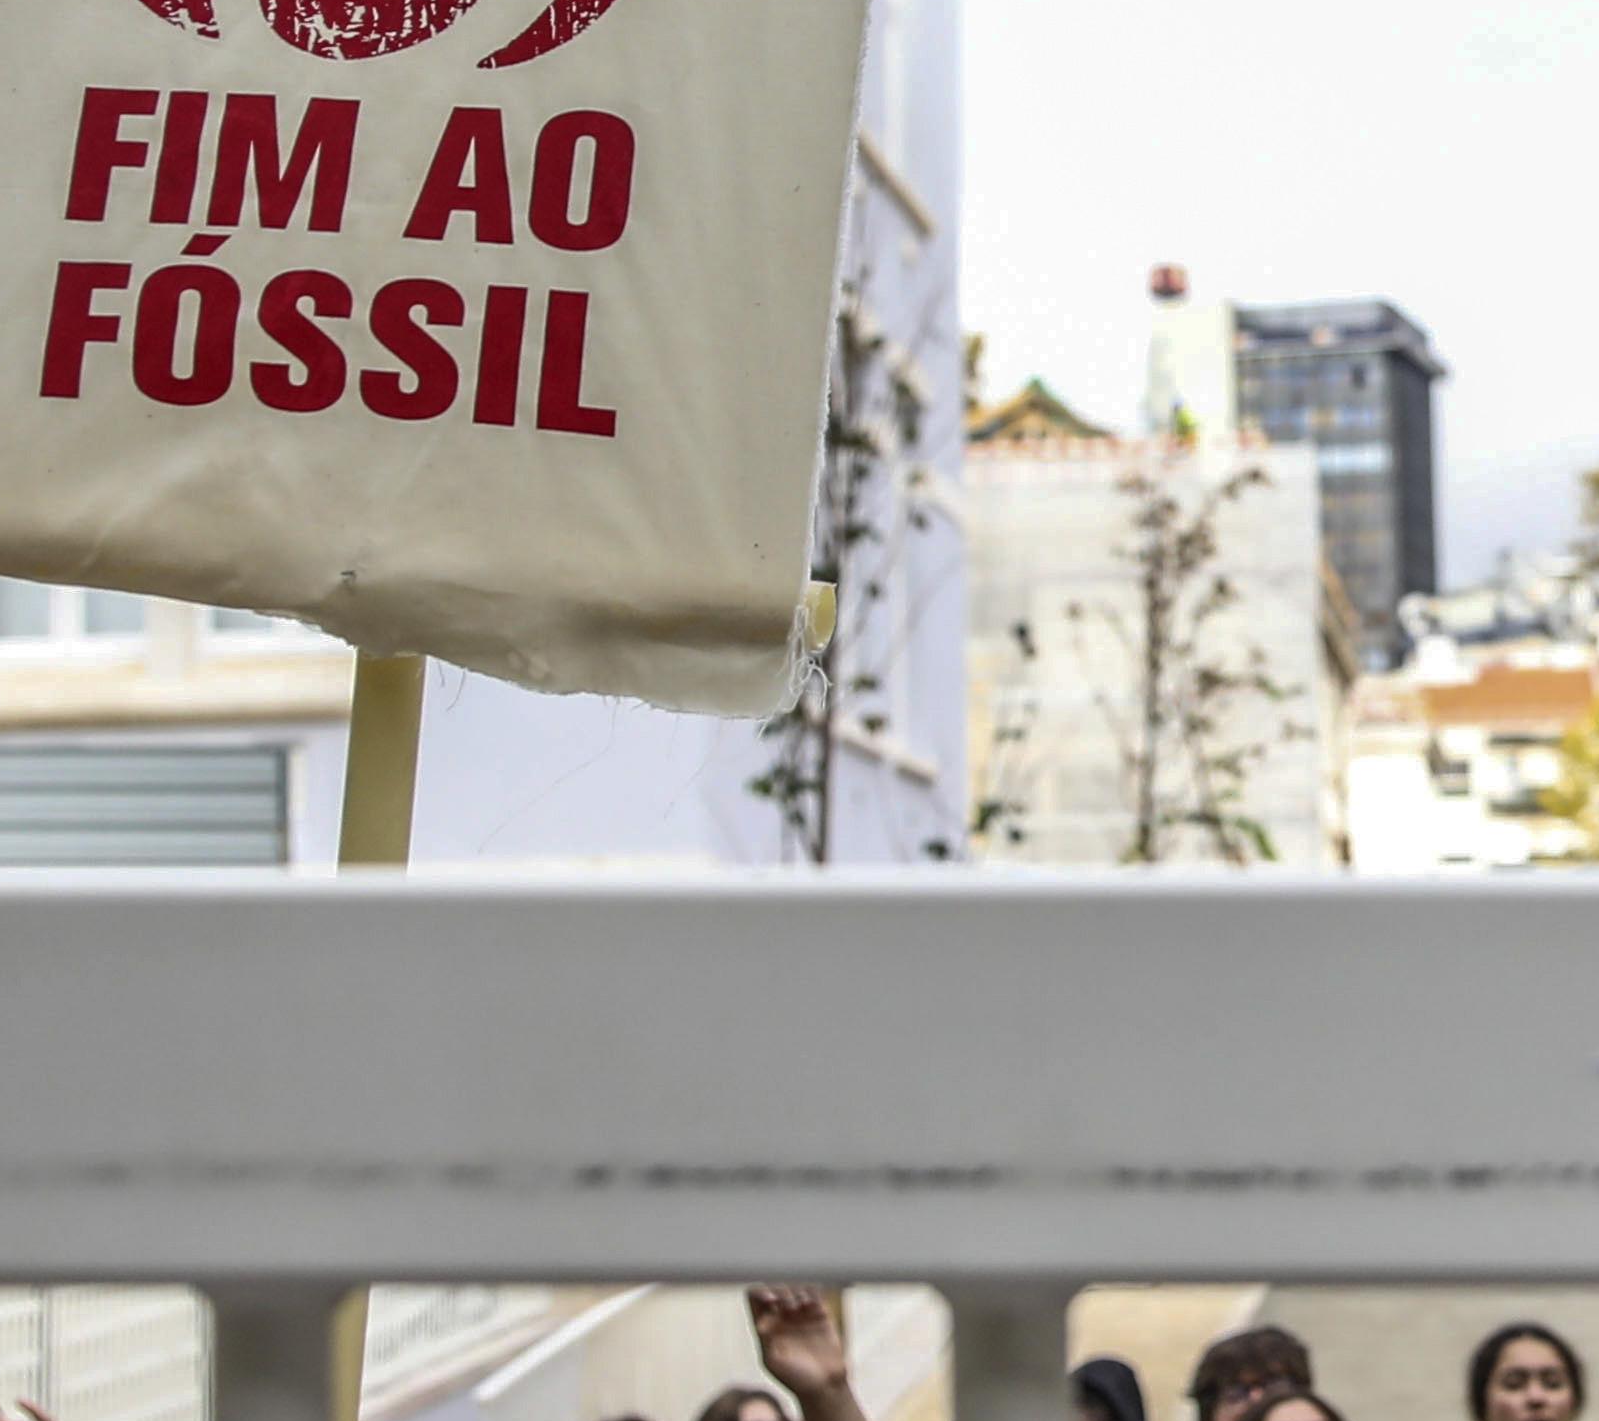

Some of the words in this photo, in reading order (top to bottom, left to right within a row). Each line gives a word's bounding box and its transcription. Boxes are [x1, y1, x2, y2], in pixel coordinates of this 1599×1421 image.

[65, 87, 360, 232] FIM
[405, 107, 635, 251] AO
[41, 234, 617, 437] FÓSSIL
